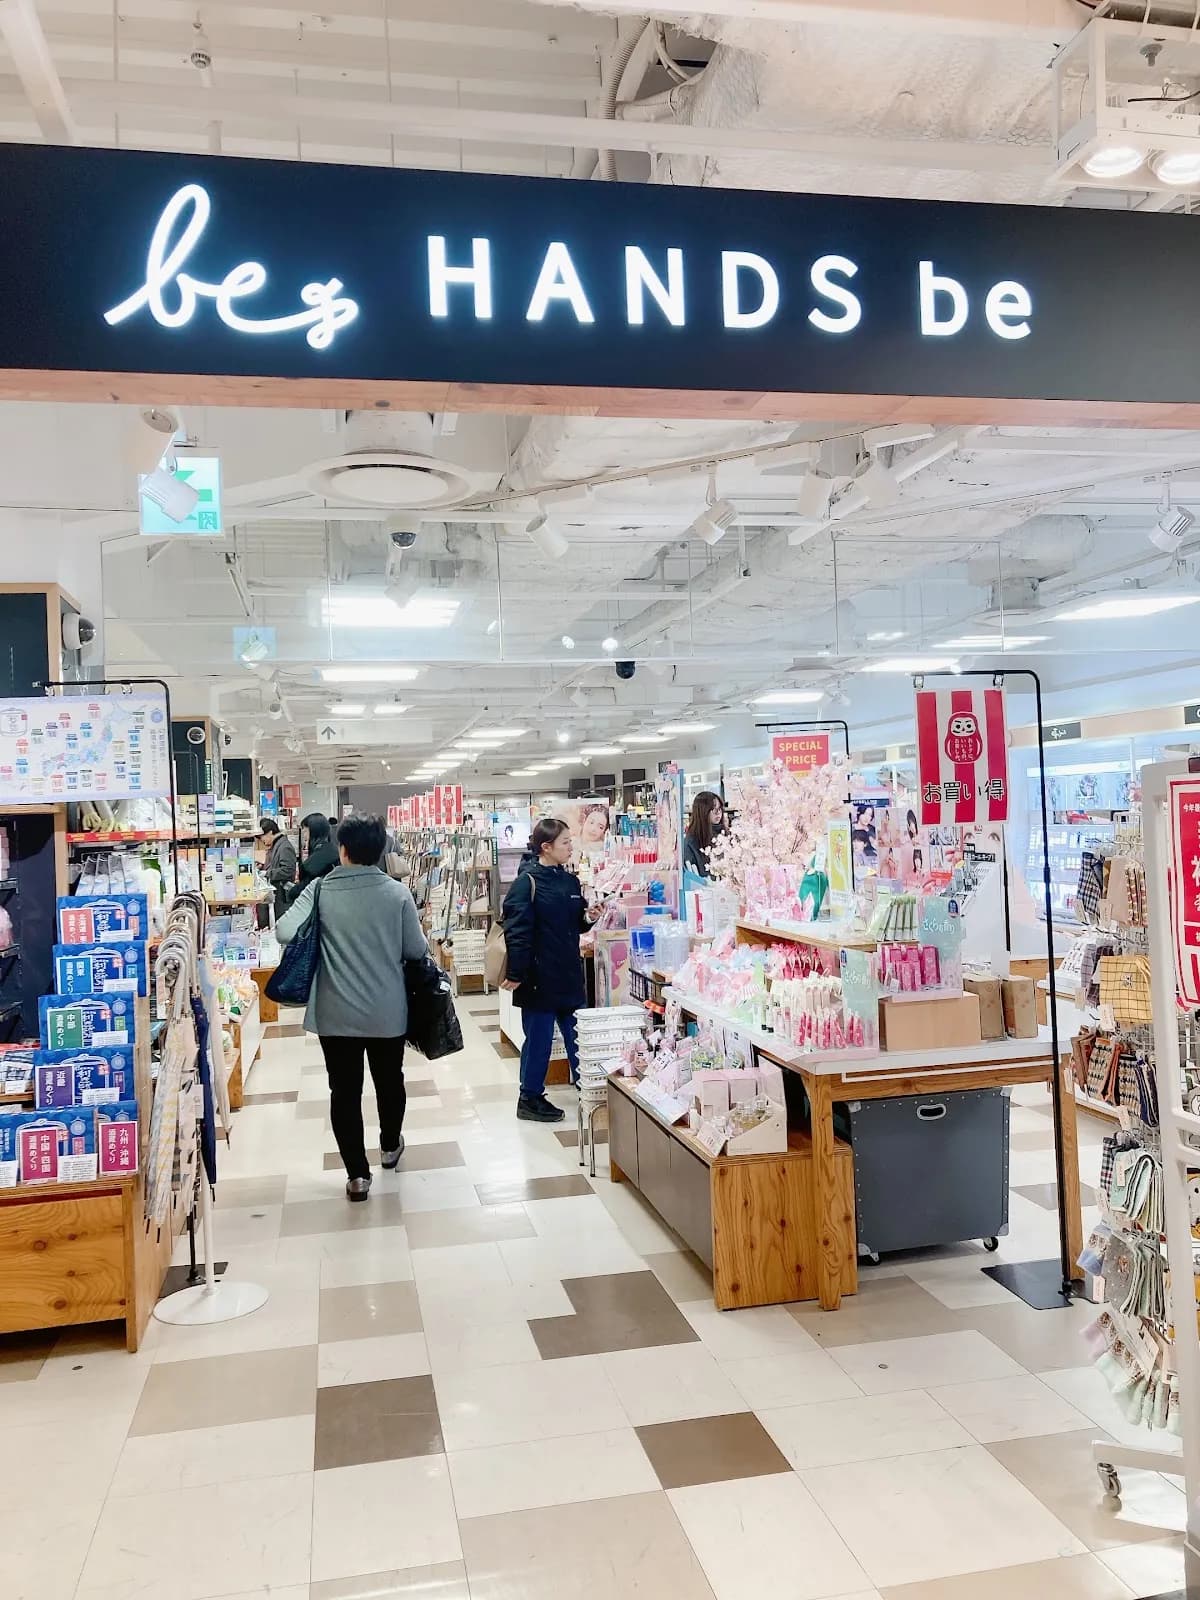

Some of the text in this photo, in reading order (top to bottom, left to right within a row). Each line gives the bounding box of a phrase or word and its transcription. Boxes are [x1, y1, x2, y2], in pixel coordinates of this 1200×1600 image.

[426, 234, 1033, 340] HANDS be
[778, 740, 824, 752] SPECIAL
[785, 754, 817, 766] PRICE
[923, 778, 1004, 803] お買い得
[66, 1013, 77, 1030] 中部
[56, 1070, 66, 1087] 近畿
[119, 1128, 129, 1166] 九州・沖縄
